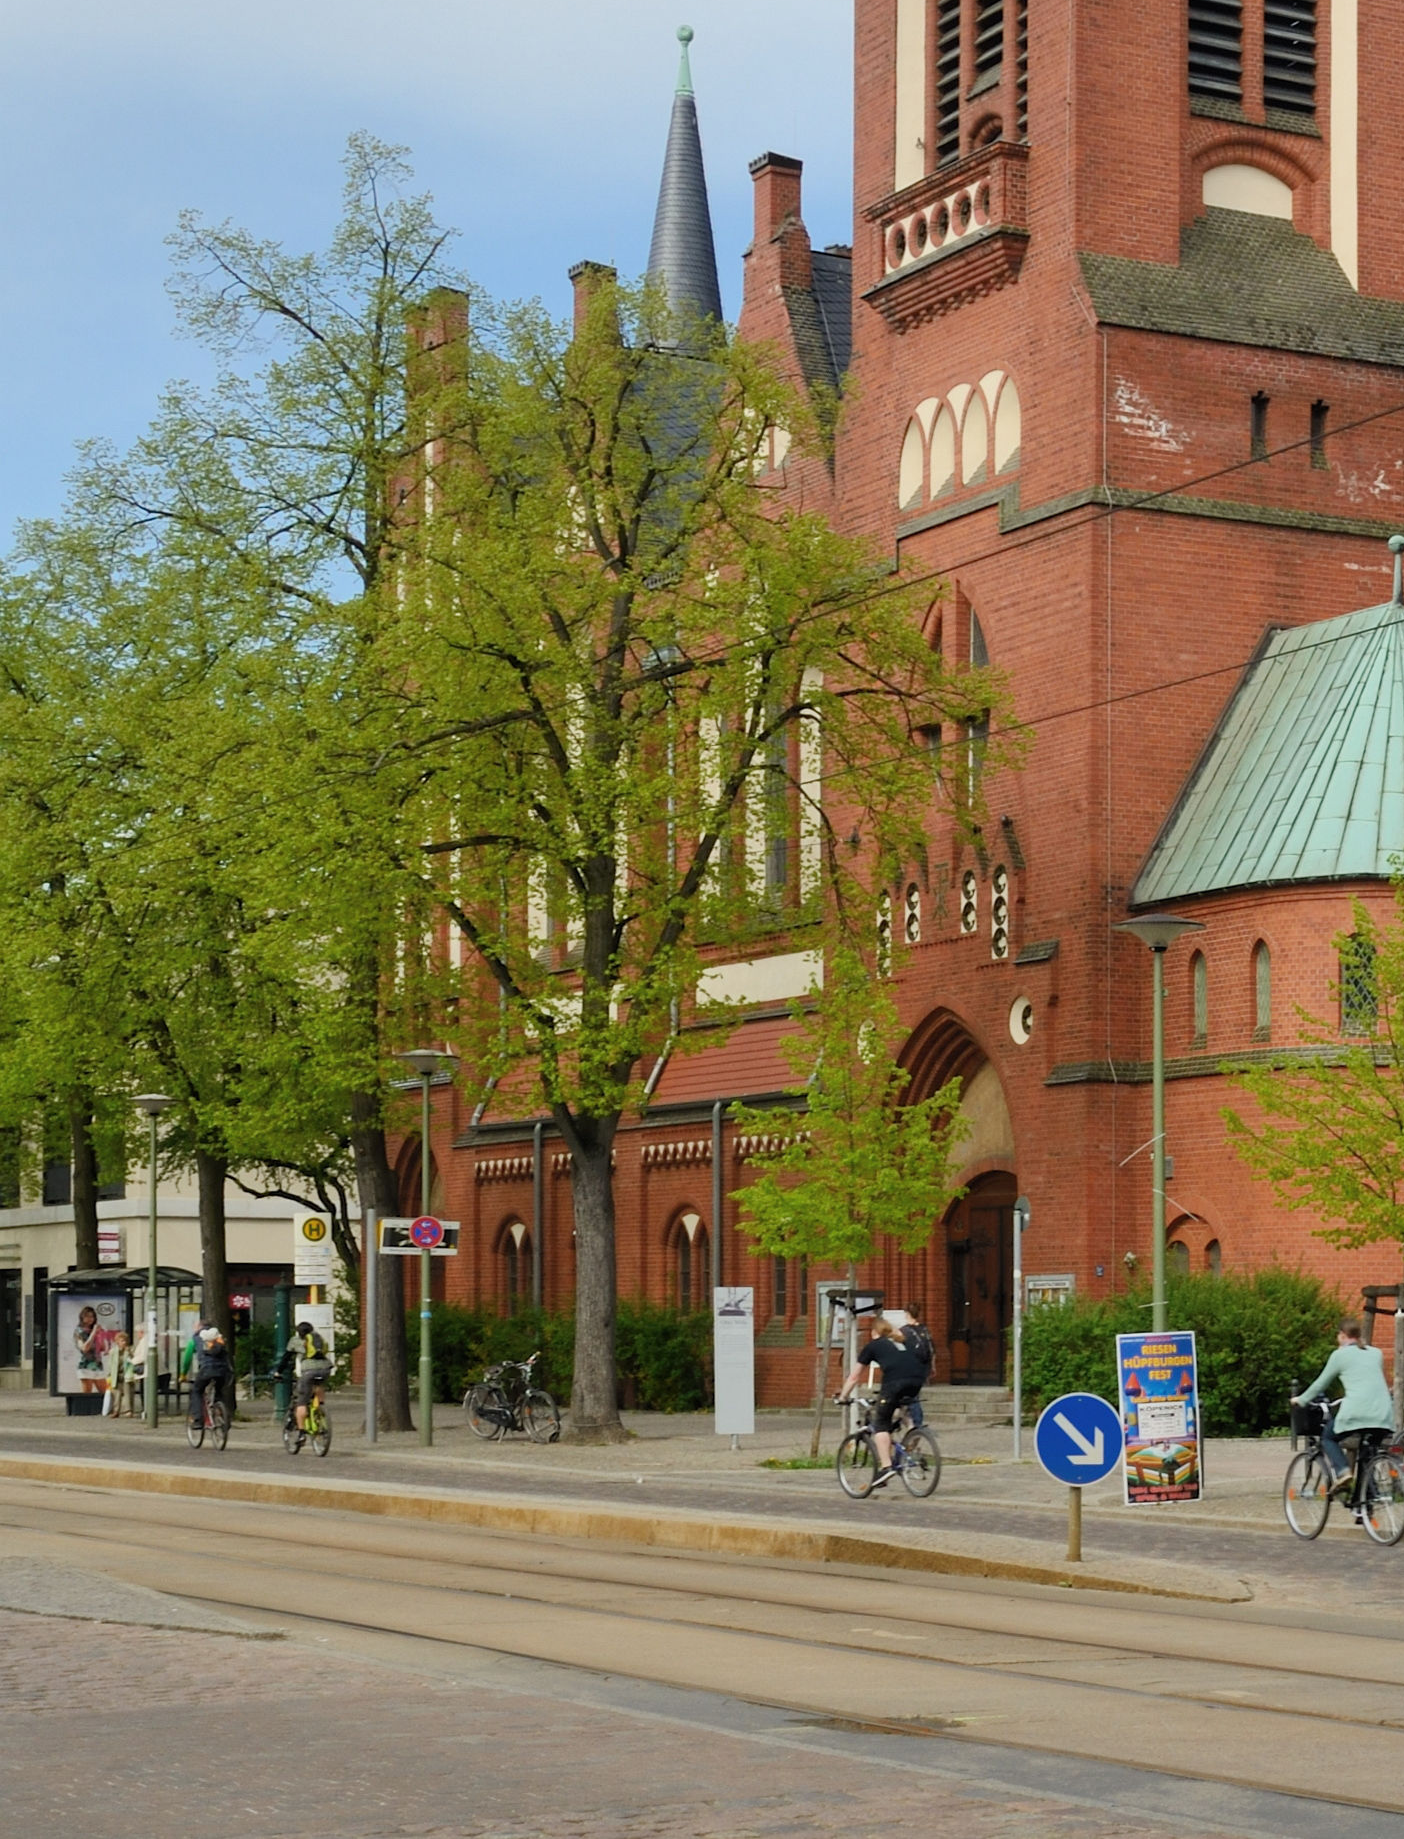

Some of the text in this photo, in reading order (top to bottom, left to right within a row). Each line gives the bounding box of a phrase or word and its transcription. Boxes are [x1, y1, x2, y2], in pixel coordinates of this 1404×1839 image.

[308, 1222, 321, 1237] H
[1141, 1344, 1177, 1356] RIESEN
[1123, 1355, 1193, 1369] HÜPFBURGEN
[1149, 1369, 1172, 1380] FEST
